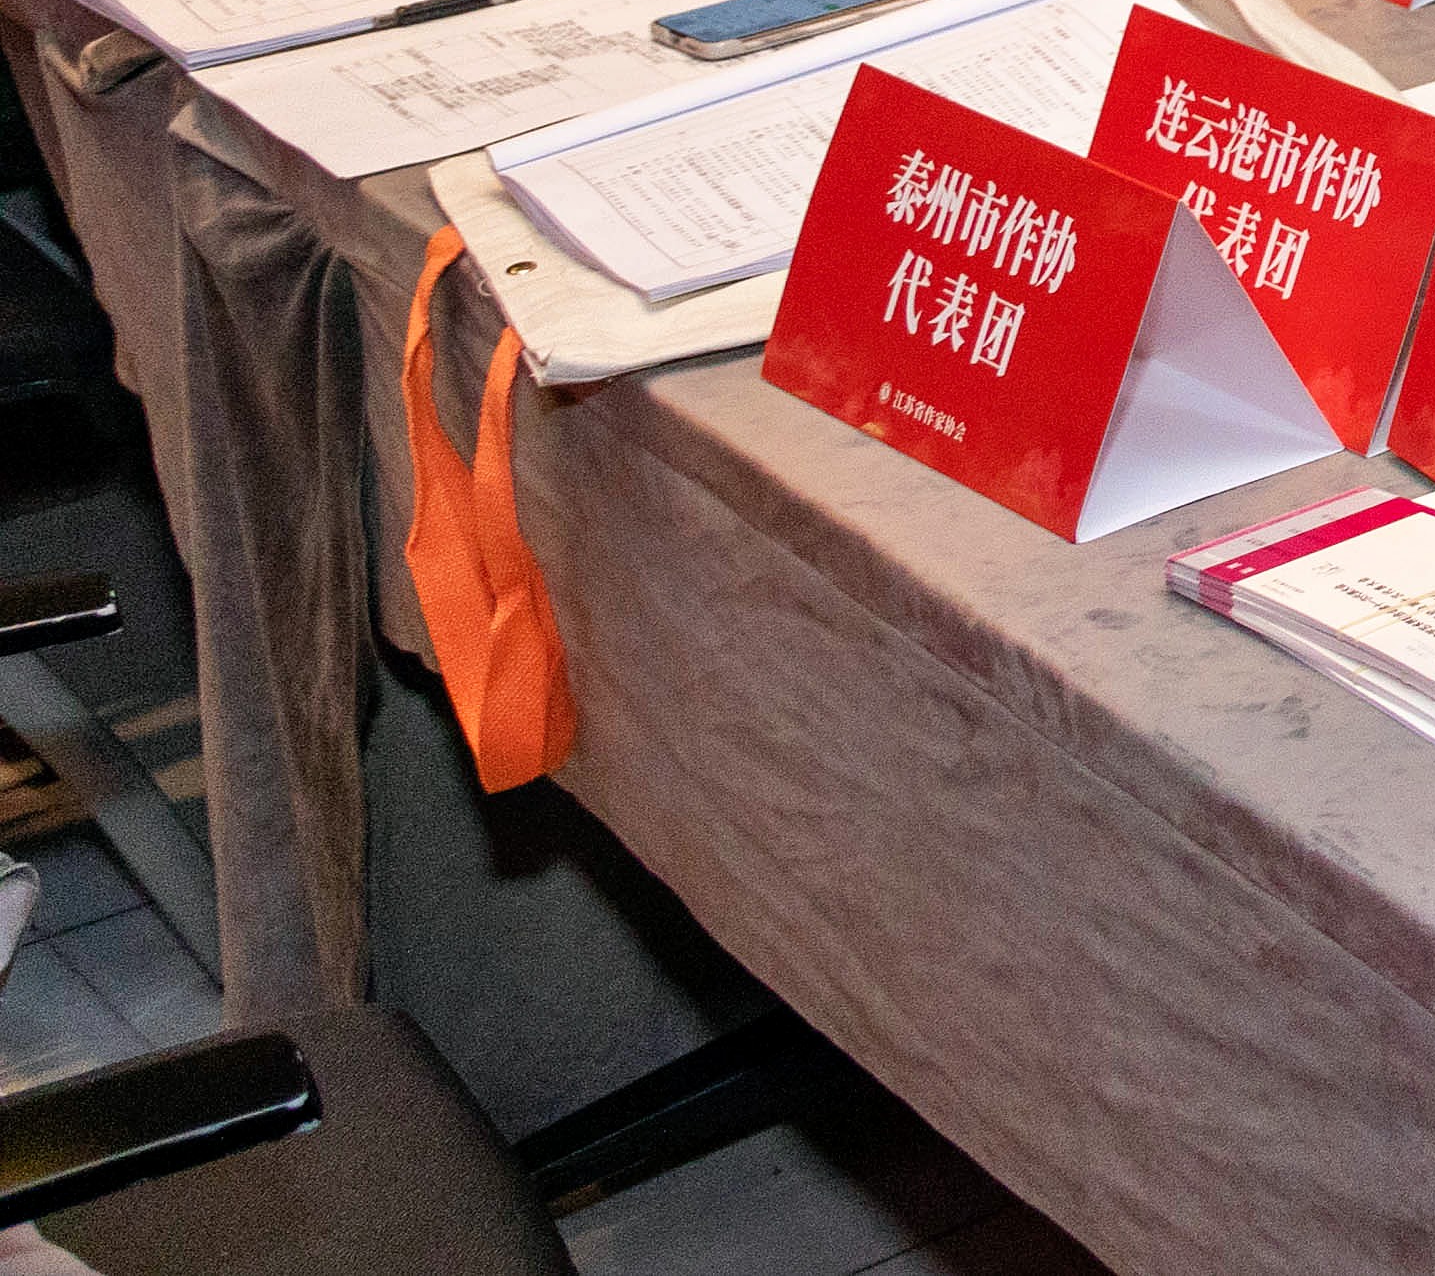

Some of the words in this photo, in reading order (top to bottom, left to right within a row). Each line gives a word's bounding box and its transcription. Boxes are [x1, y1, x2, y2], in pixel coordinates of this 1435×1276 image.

[1146, 76, 1381, 227] 连云港市作协
[886, 150, 1077, 293] 泰州市作协
[884, 249, 1025, 377] 代表团
[893, 391, 966, 442] 江苏省作家协会
